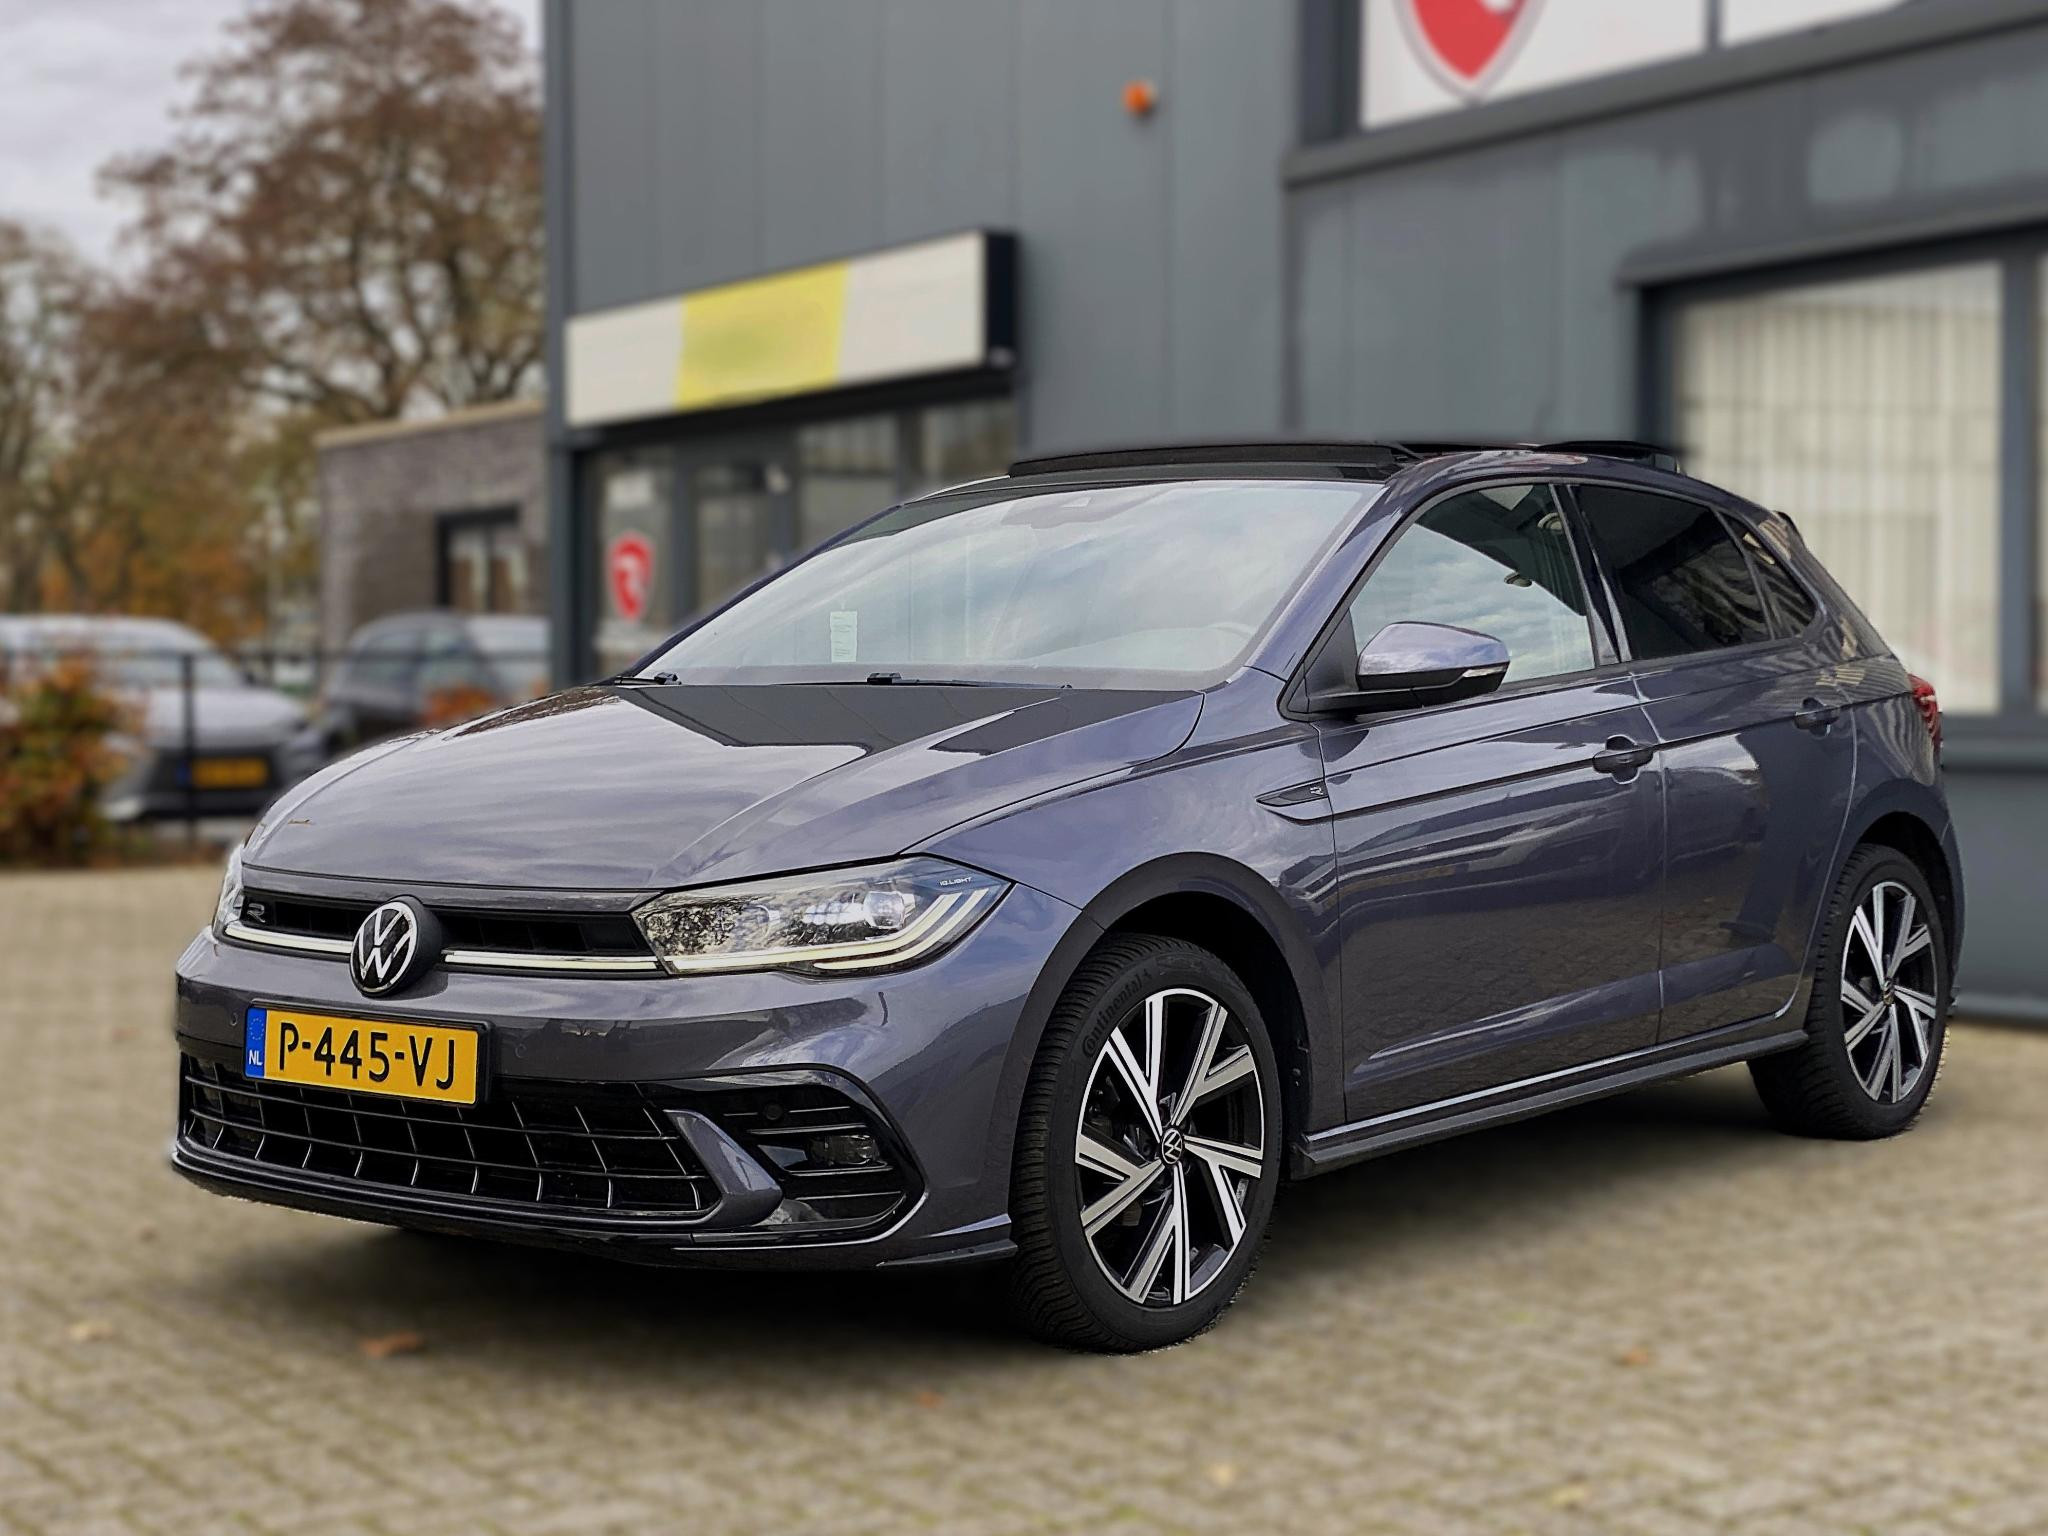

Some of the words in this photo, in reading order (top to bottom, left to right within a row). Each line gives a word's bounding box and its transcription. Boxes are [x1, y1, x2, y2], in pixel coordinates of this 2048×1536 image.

[247, 903, 265, 922] R
[248, 1049, 263, 1067] NL
[279, 1021, 455, 1090] P-445-VJ
